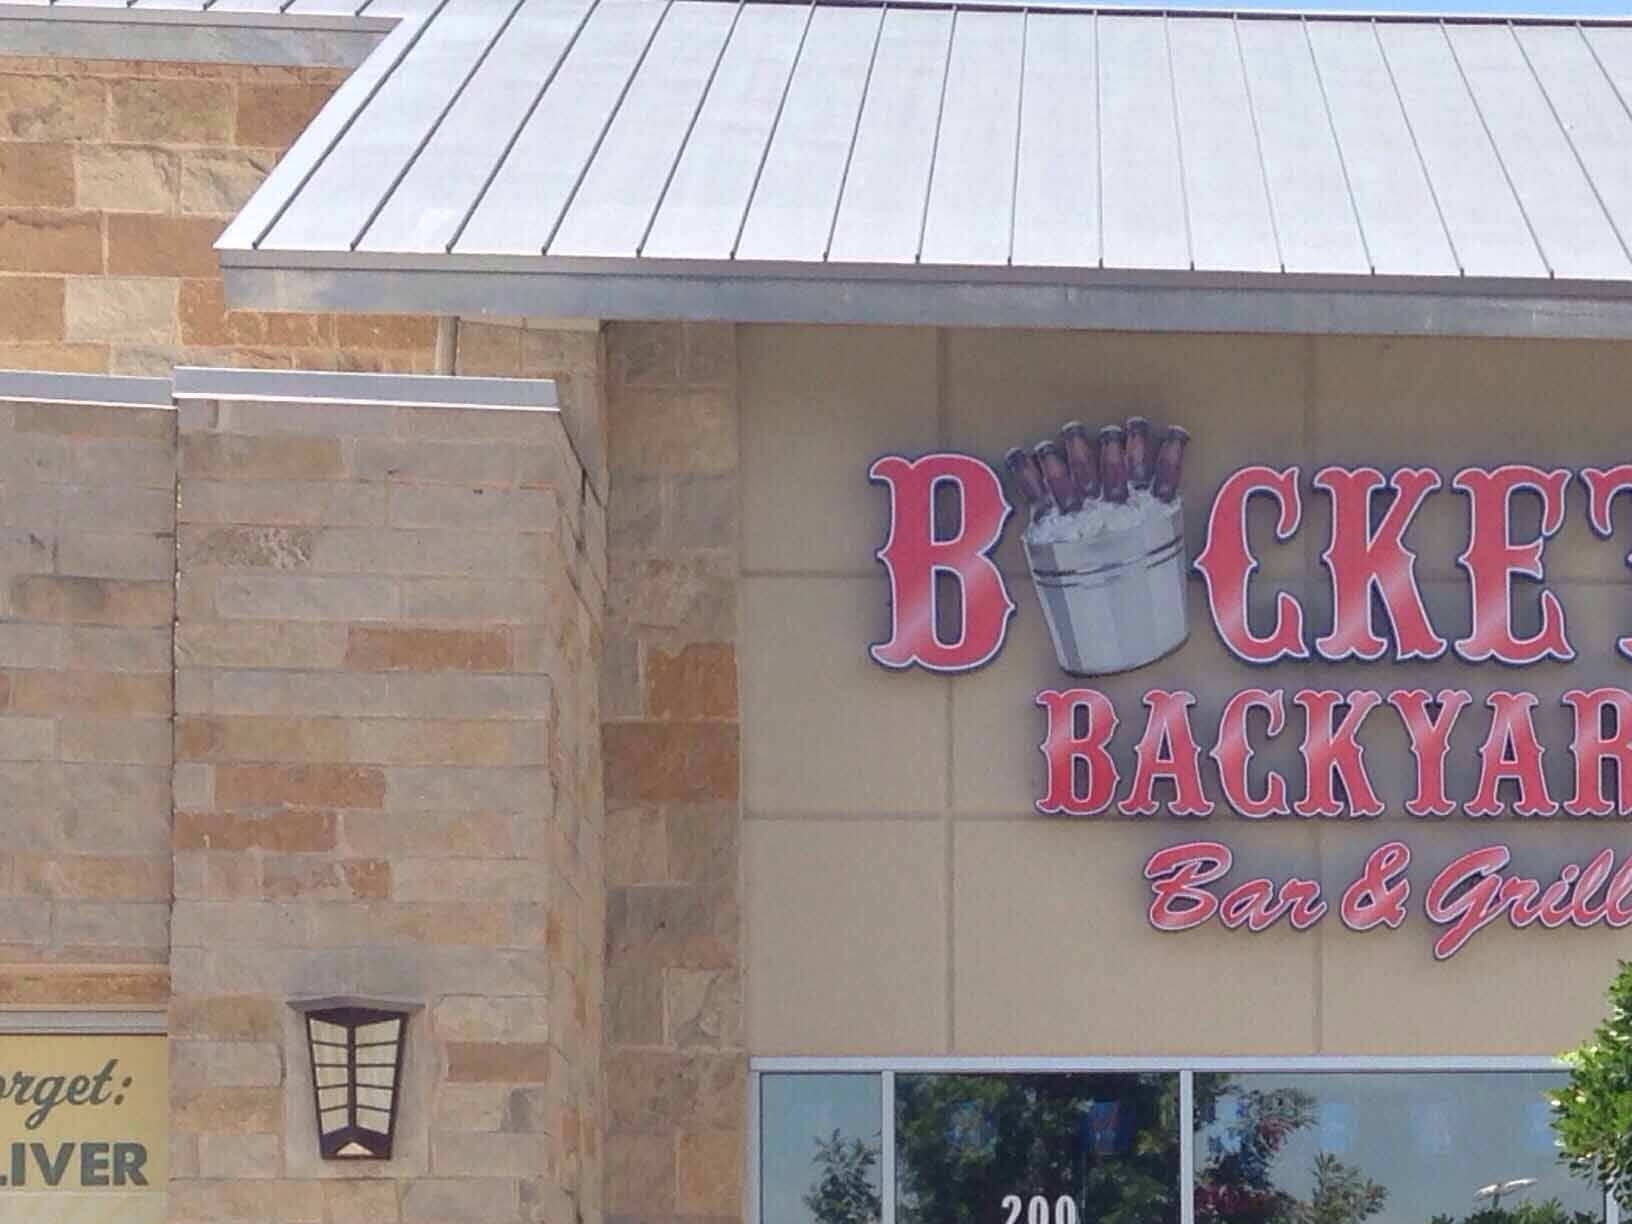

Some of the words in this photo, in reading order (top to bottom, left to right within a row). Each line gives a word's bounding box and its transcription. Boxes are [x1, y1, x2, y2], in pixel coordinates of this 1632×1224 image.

[1144, 841, 1328, 932] Bar
[1340, 841, 1411, 931] &
[0, 1142, 149, 1187] IVER
